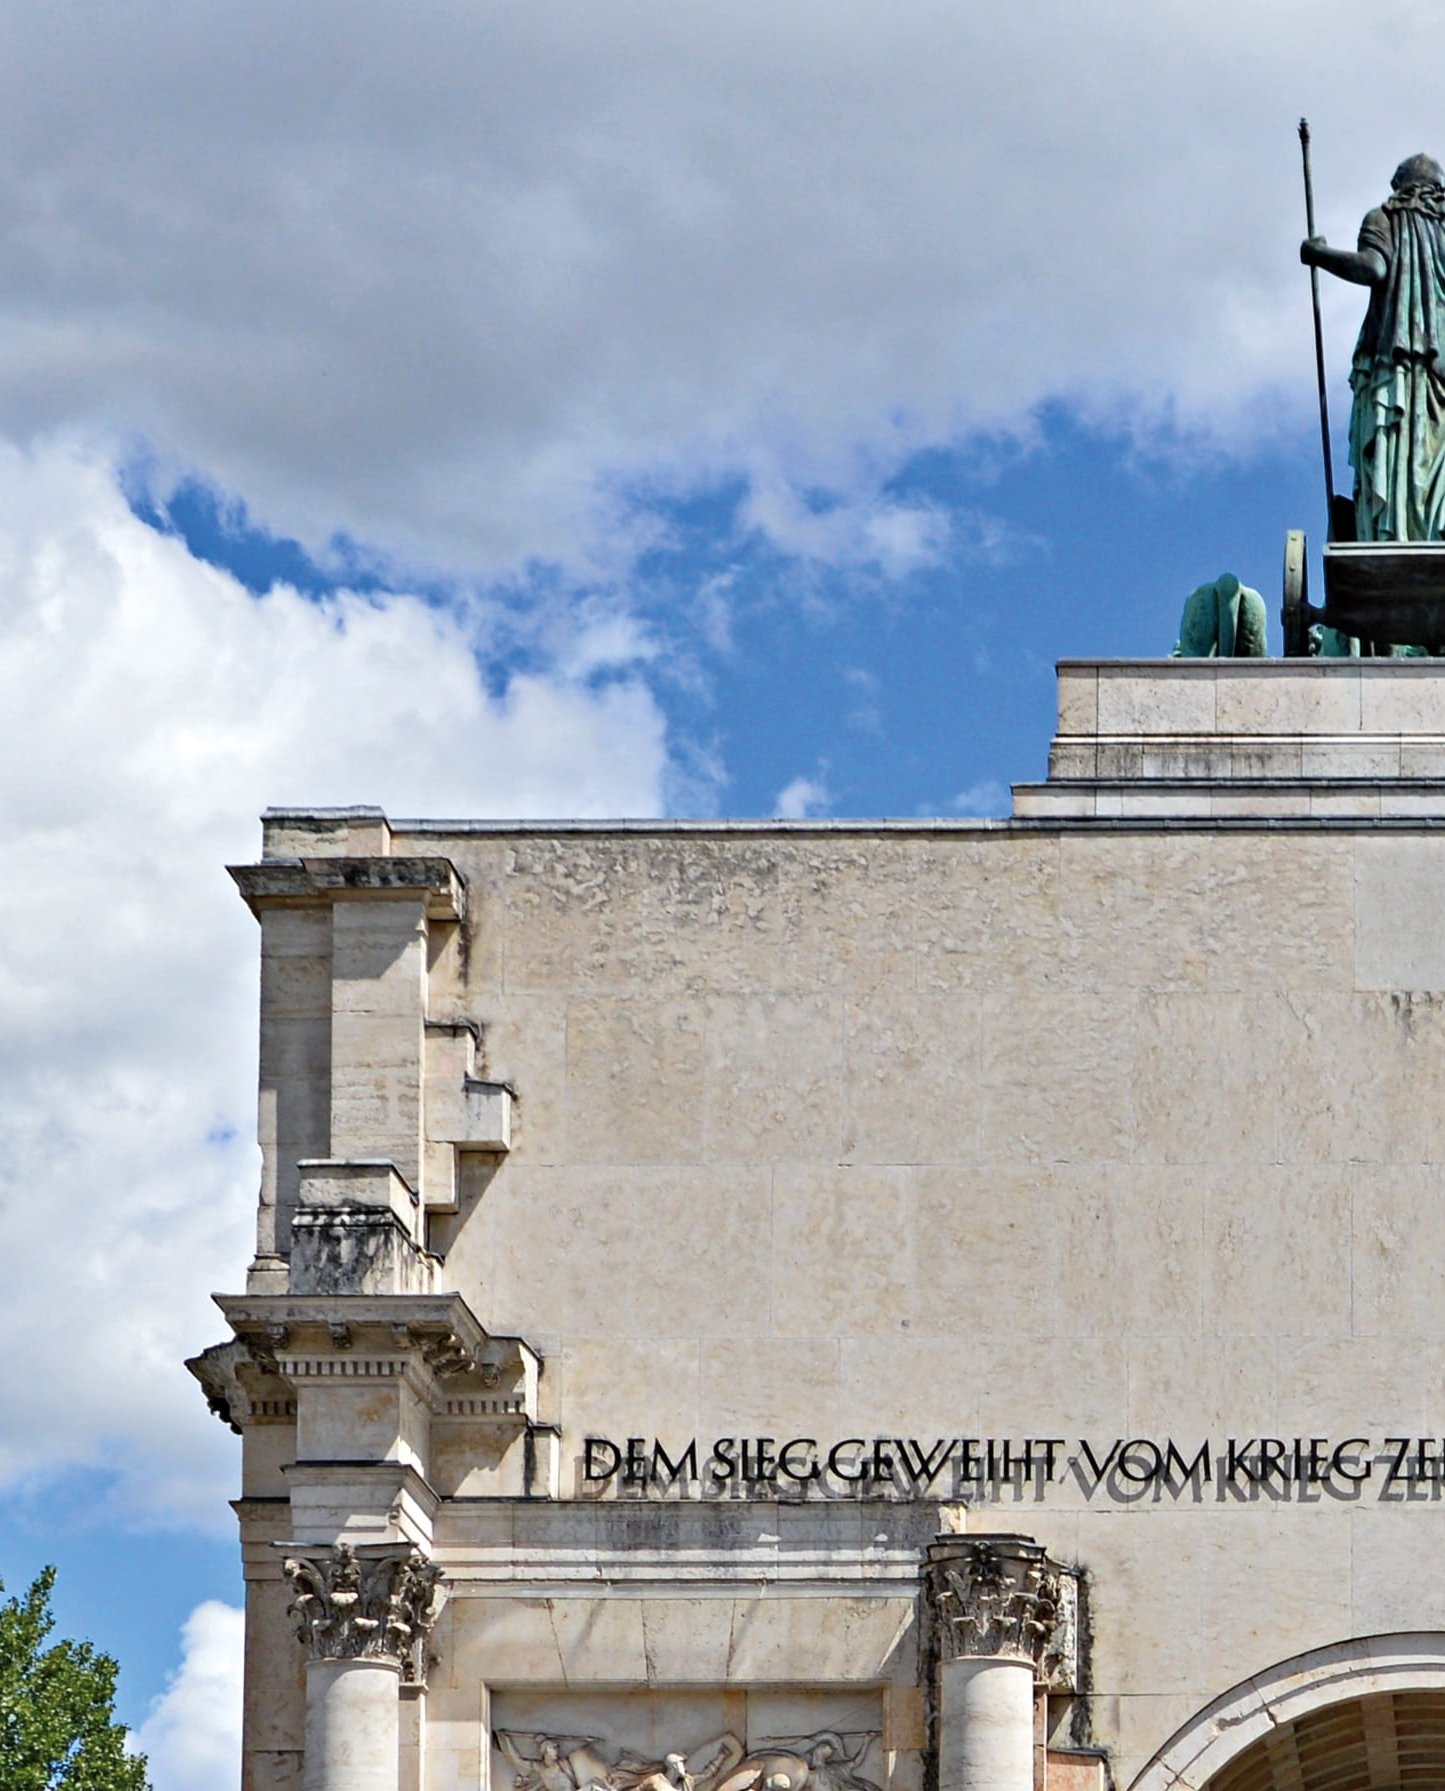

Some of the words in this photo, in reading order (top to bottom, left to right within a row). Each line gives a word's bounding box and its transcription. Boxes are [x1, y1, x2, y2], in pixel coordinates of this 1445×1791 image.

[584, 1438, 699, 1482] DEM
[712, 1438, 822, 1482] SIEG
[827, 1438, 1065, 1482] GEWEIHT
[1078, 1438, 1212, 1482] VOM
[1226, 1438, 1371, 1482] KRIEG
